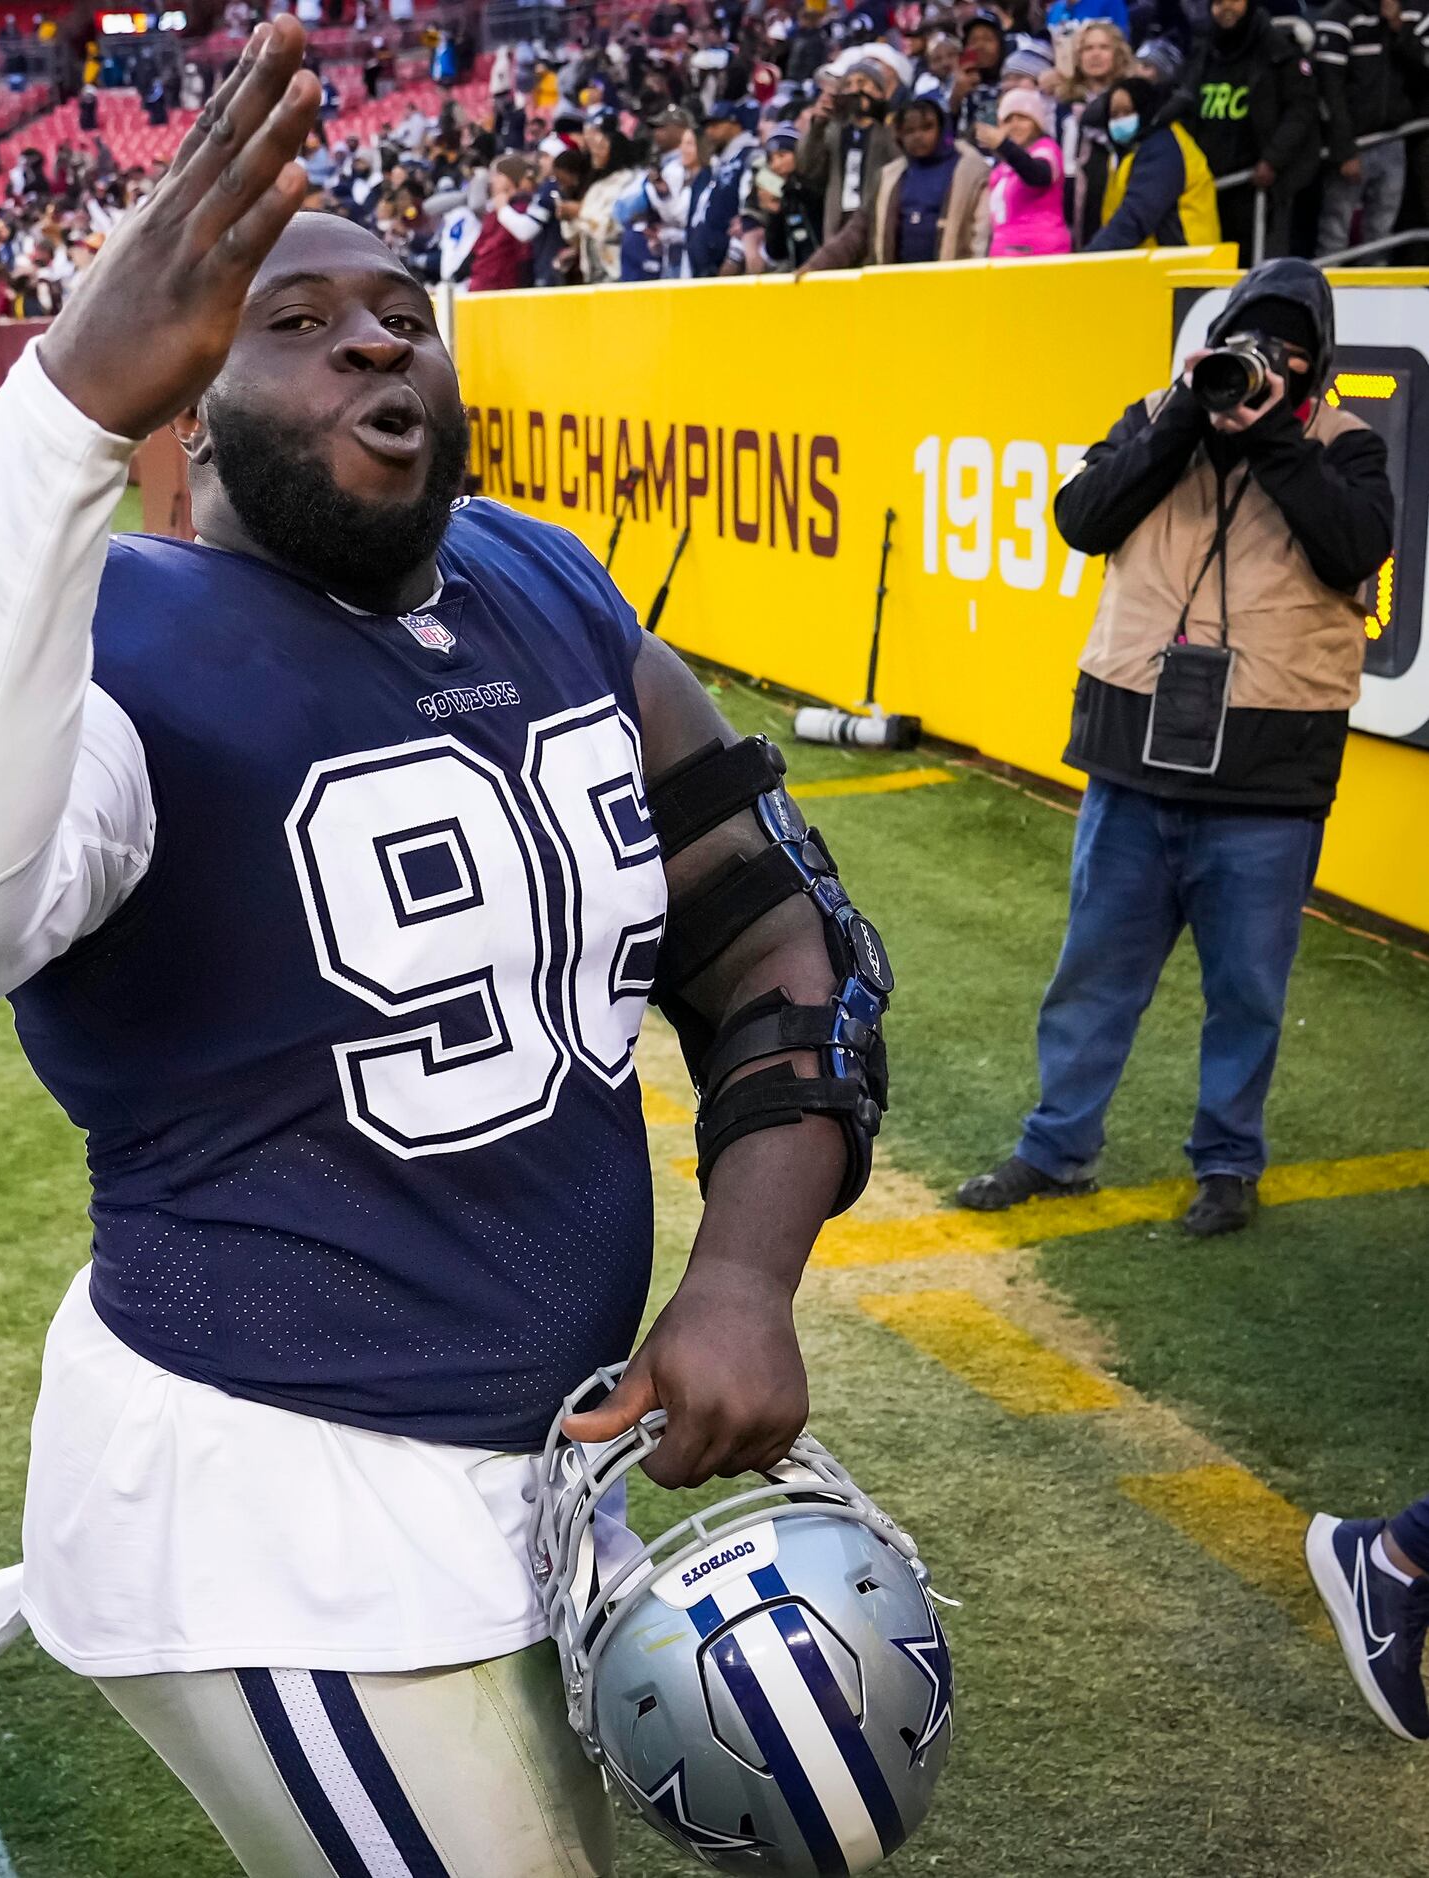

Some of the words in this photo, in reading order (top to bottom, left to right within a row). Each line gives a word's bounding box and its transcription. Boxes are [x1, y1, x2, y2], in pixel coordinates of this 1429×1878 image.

[464, 405, 547, 502] ORLD
[558, 412, 841, 559] CHAMPIONS
[416, 681, 521, 722] COWBOYS
[283, 693, 669, 1160] 96
[681, 1541, 756, 1587] COWBOYS
